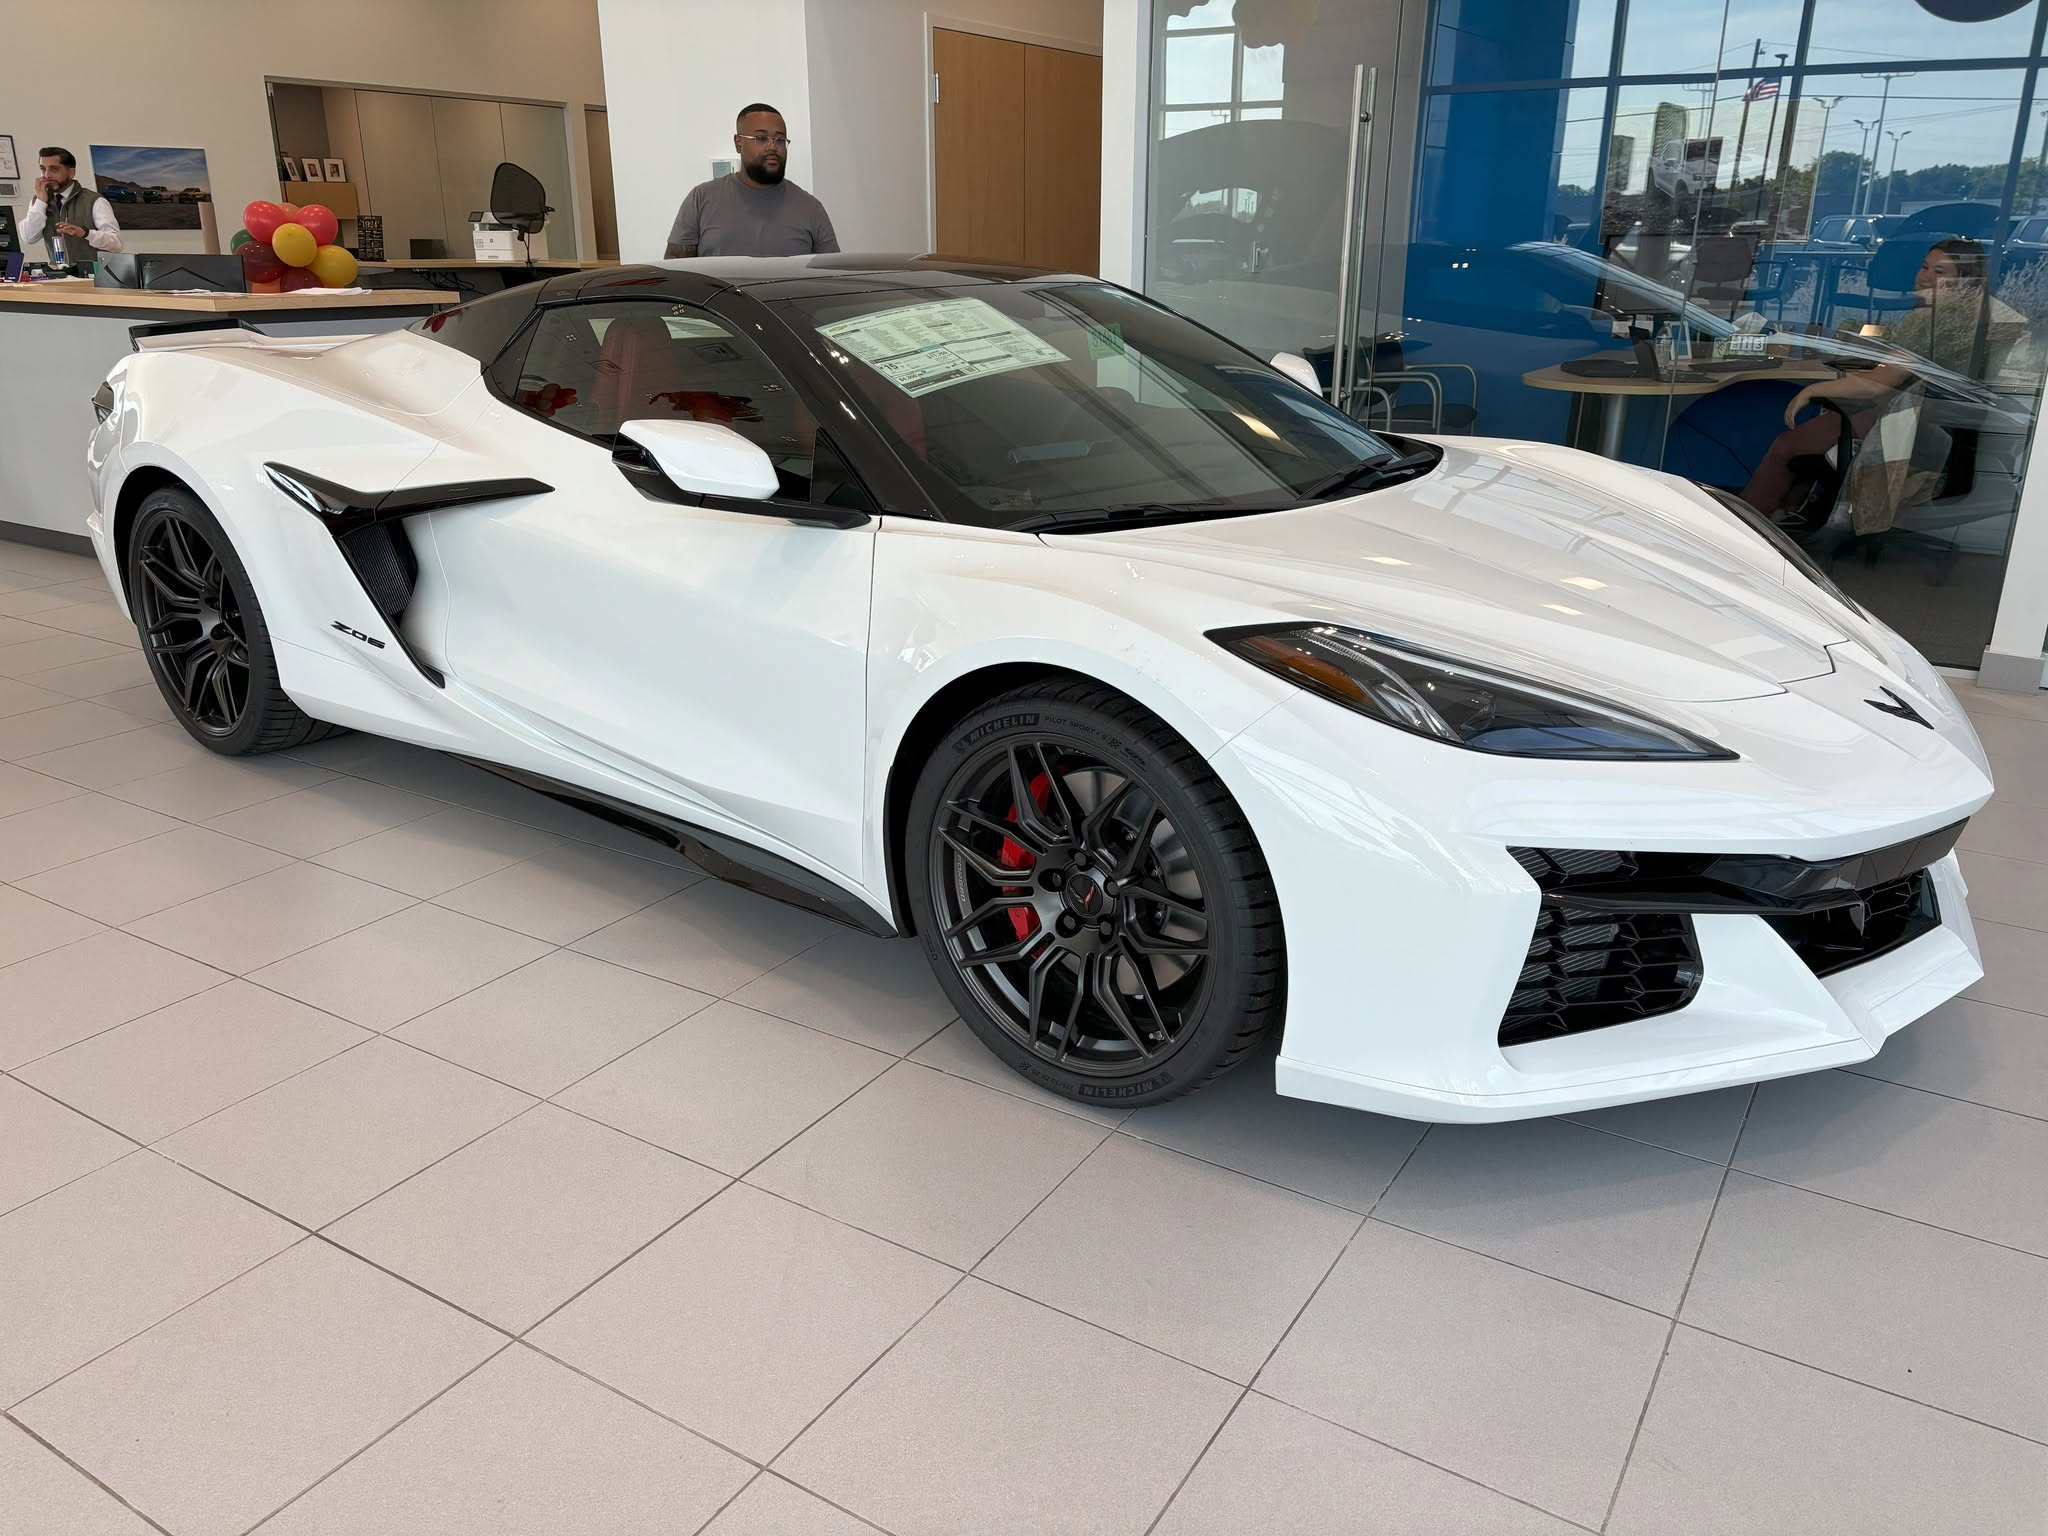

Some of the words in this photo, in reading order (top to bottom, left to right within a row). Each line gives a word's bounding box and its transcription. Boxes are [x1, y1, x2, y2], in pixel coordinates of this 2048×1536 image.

[330, 620, 386, 650] Z06
[969, 713, 1036, 746] MICHELIN
[1045, 716, 1067, 726] PILOT
[1068, 720, 1096, 735] SPORT
[1083, 1079, 1154, 1097] MICHELIN
